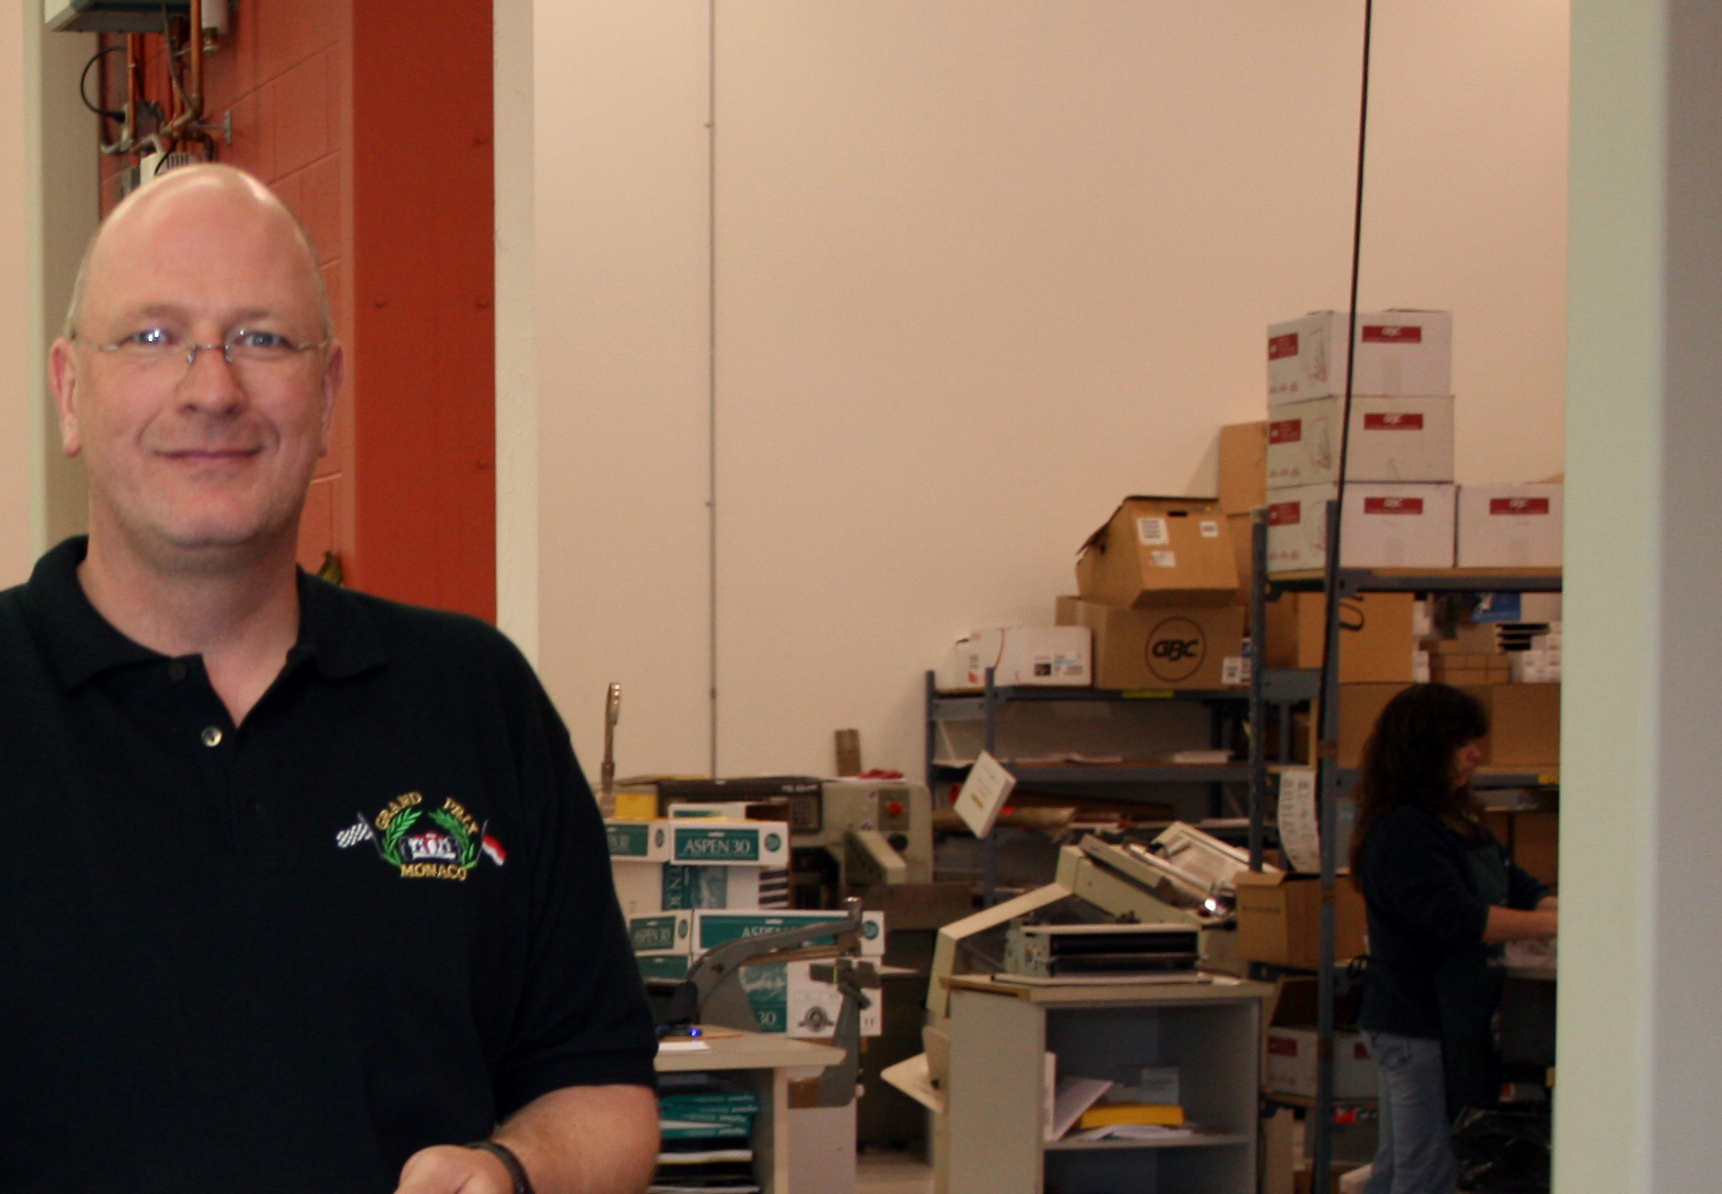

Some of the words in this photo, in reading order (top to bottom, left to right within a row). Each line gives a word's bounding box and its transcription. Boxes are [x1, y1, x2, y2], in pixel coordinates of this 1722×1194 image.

[1152, 639, 1199, 661] GBC
[374, 791, 422, 830] GRAND
[683, 838, 731, 854] ASPEN
[733, 838, 751, 853] 30
[400, 862, 469, 881] MONACO
[758, 1011, 777, 1025] 30
